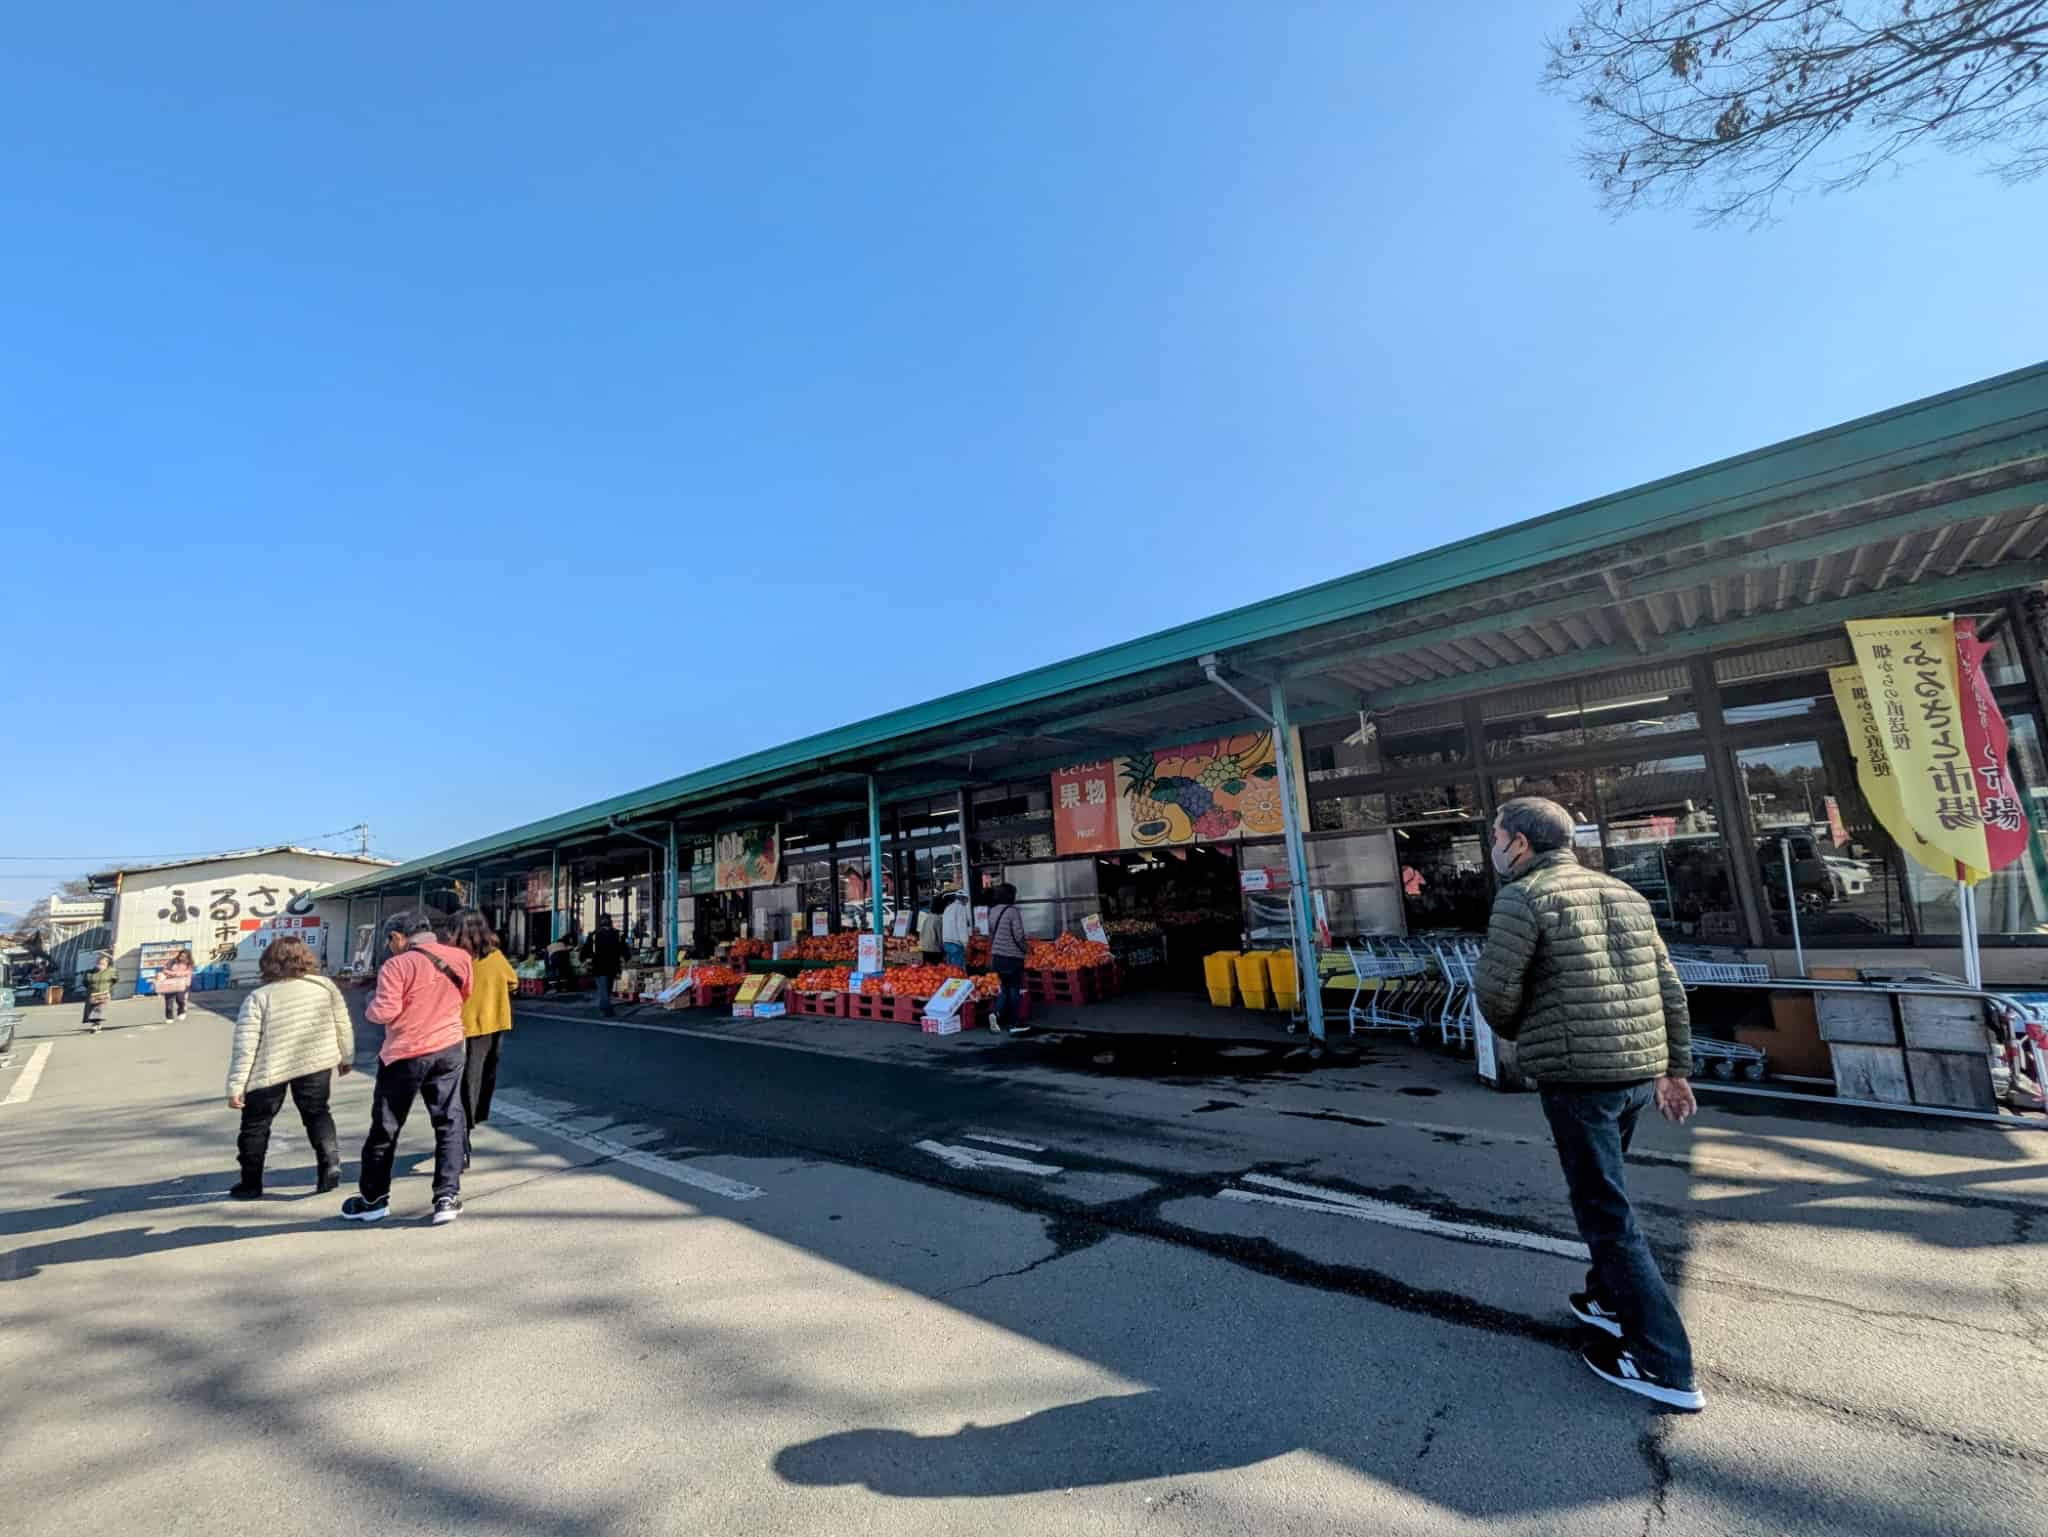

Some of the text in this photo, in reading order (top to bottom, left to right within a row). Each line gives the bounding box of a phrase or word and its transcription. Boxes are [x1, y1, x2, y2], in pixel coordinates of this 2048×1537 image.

[1059, 778, 1107, 809] 果物
[158, 886, 314, 924] ふるさと
[208, 922, 239, 961] 市場
